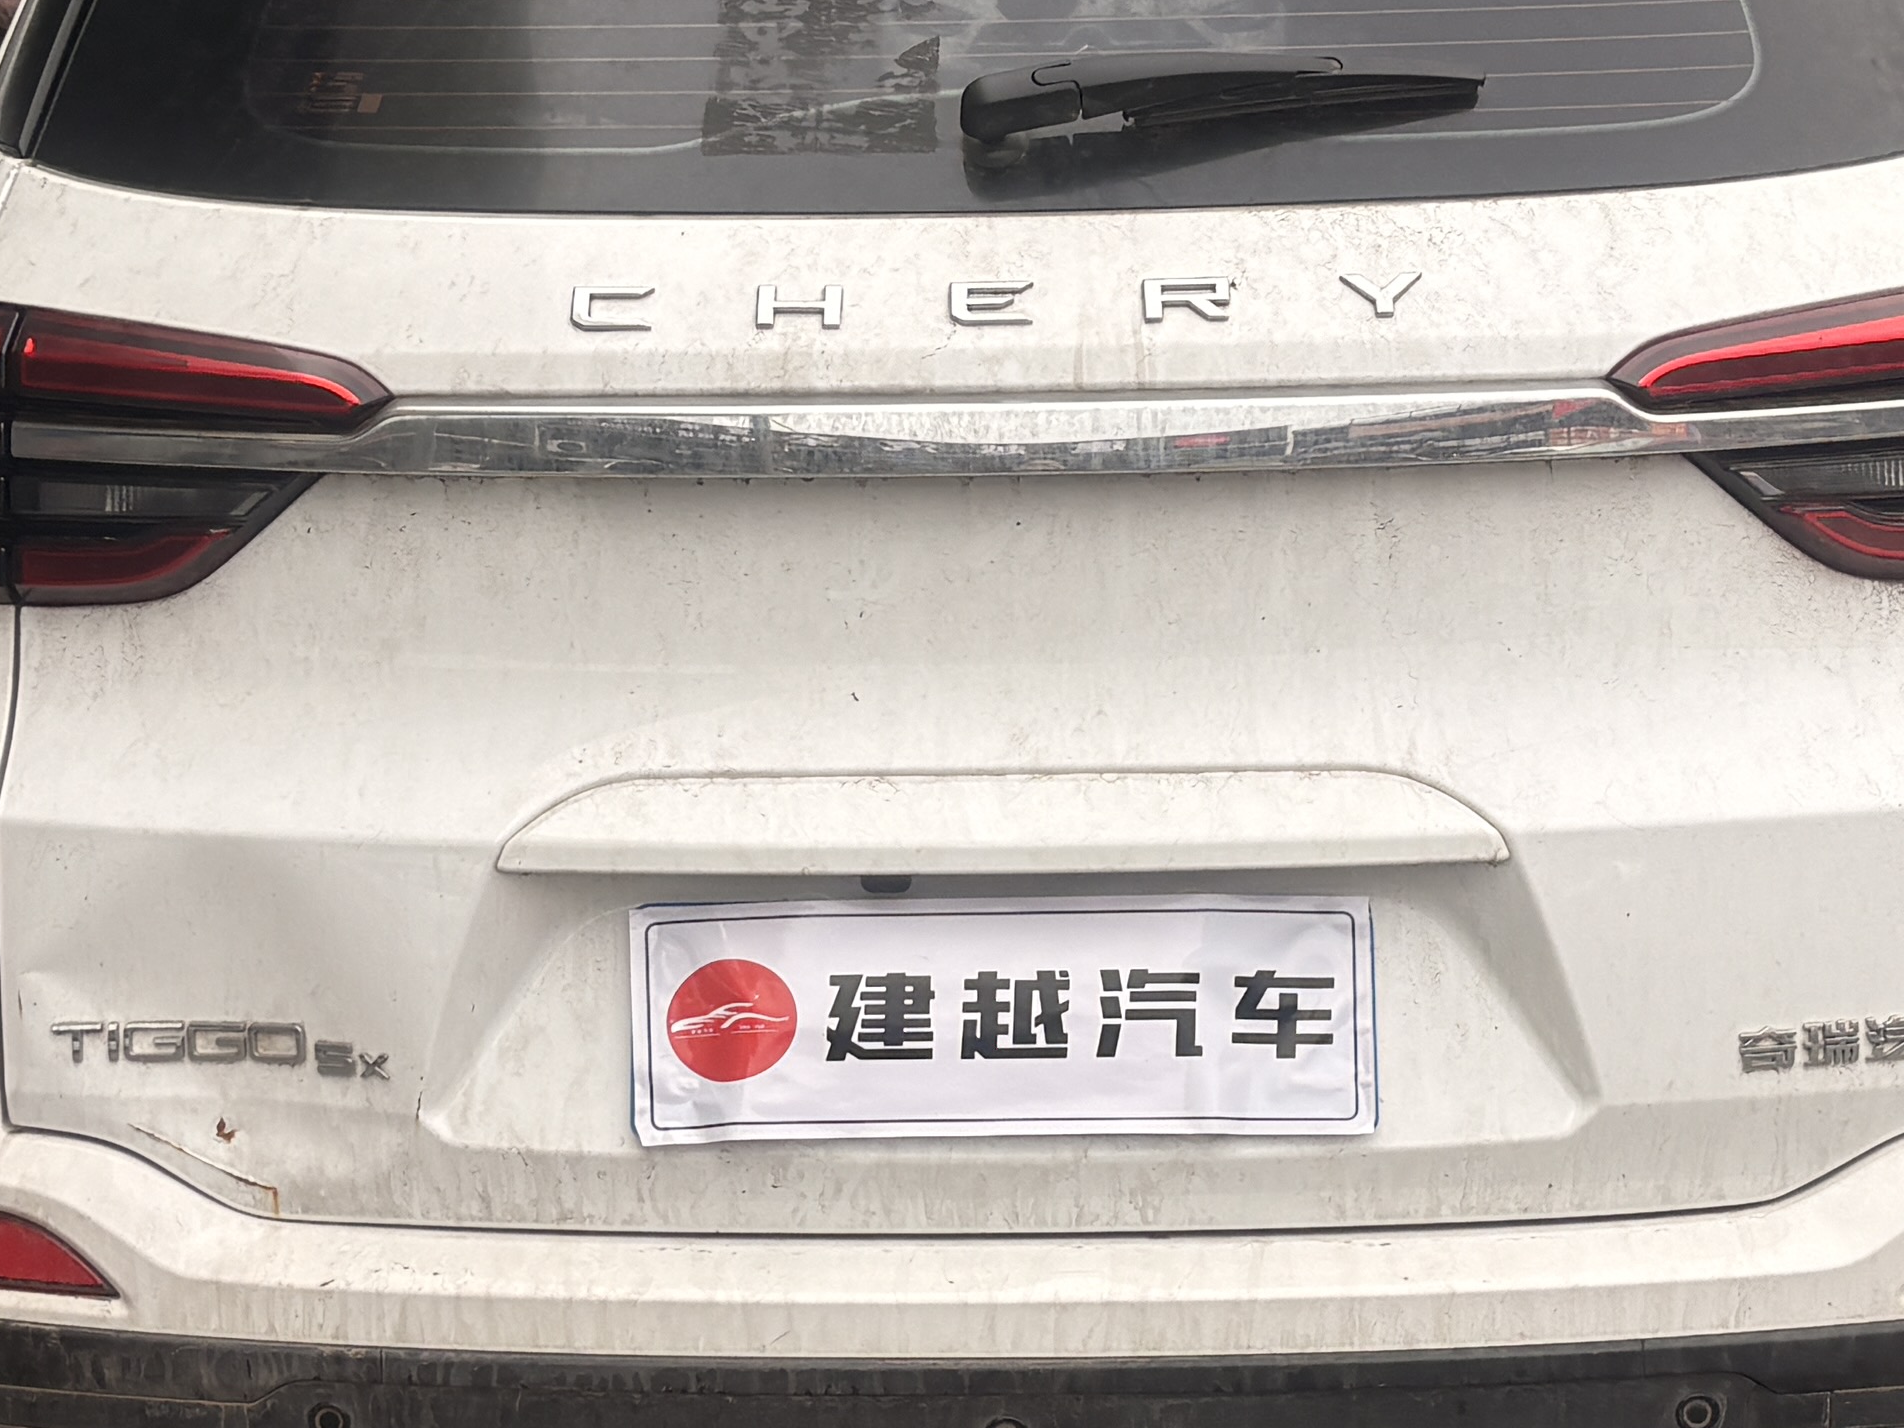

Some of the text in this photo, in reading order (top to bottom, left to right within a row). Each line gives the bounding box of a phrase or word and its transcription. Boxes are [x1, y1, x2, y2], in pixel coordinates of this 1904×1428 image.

[569, 271, 1423, 332] CHERY
[50, 1019, 307, 1065] TIGGO
[825, 968, 1336, 1063] 建越汽车
